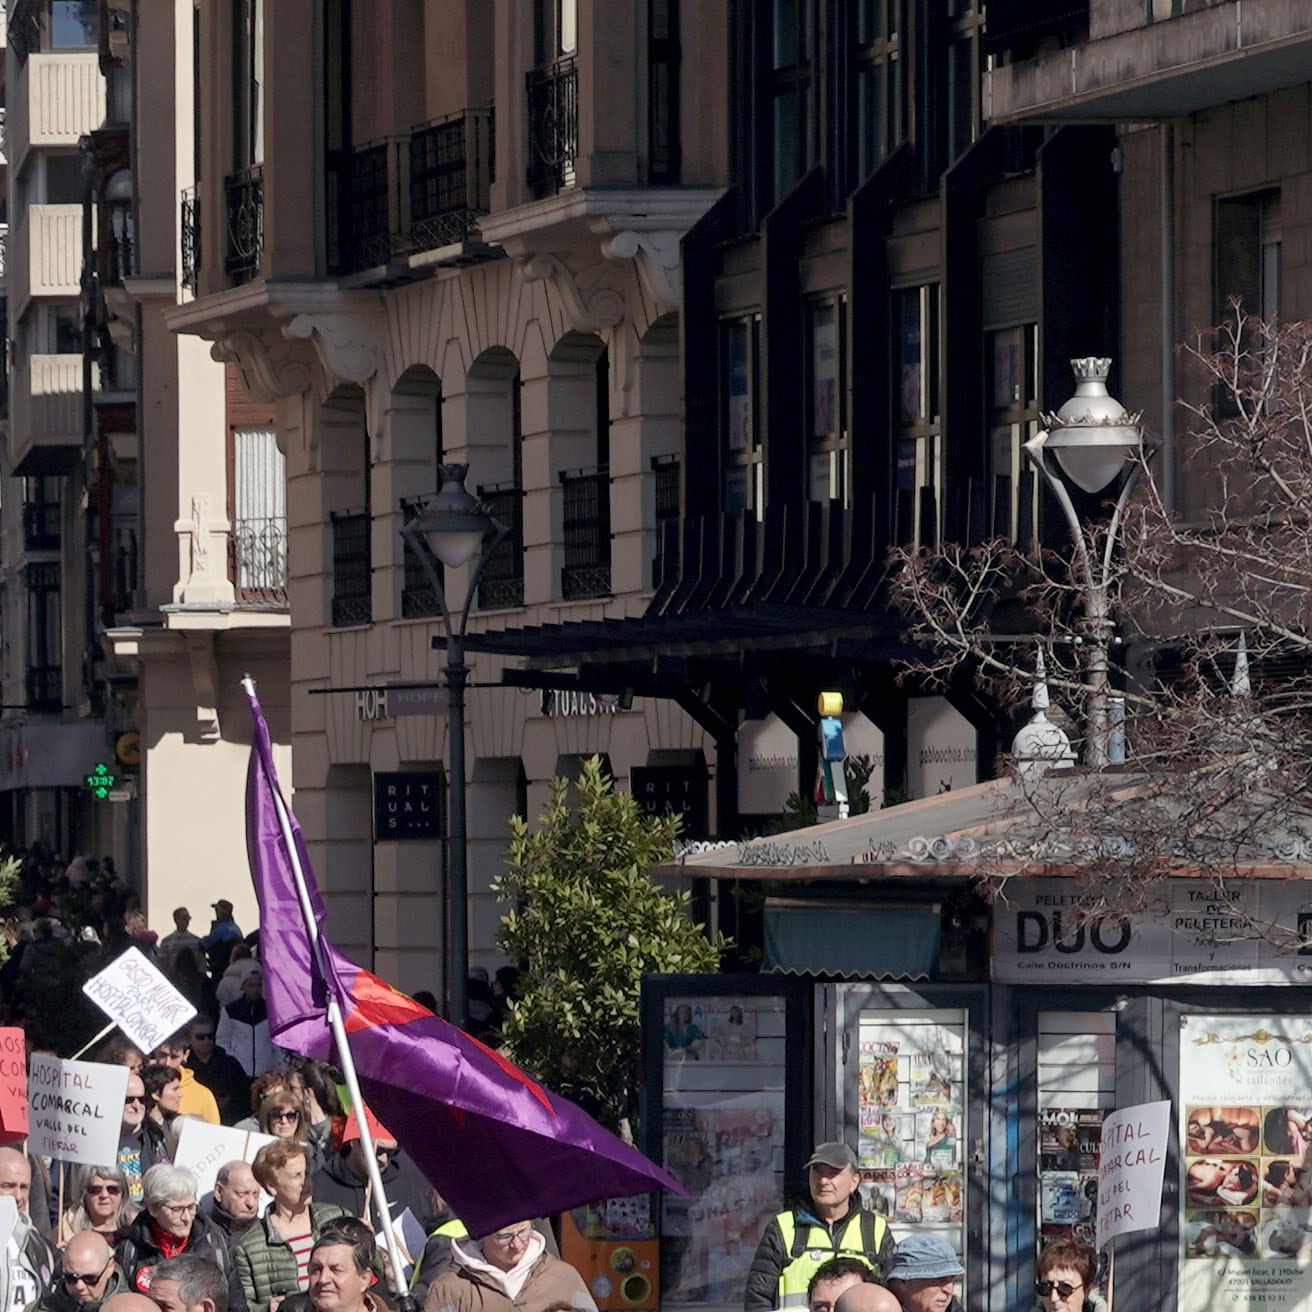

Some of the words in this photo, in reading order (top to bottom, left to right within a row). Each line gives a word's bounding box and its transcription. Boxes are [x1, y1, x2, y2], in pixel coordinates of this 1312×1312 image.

[1017, 910, 1132, 955] DUO
[1246, 1047, 1293, 1068] SAO
[31, 1061, 94, 1090] HOSPITAL
[31, 1092, 105, 1119] COMARCAL
